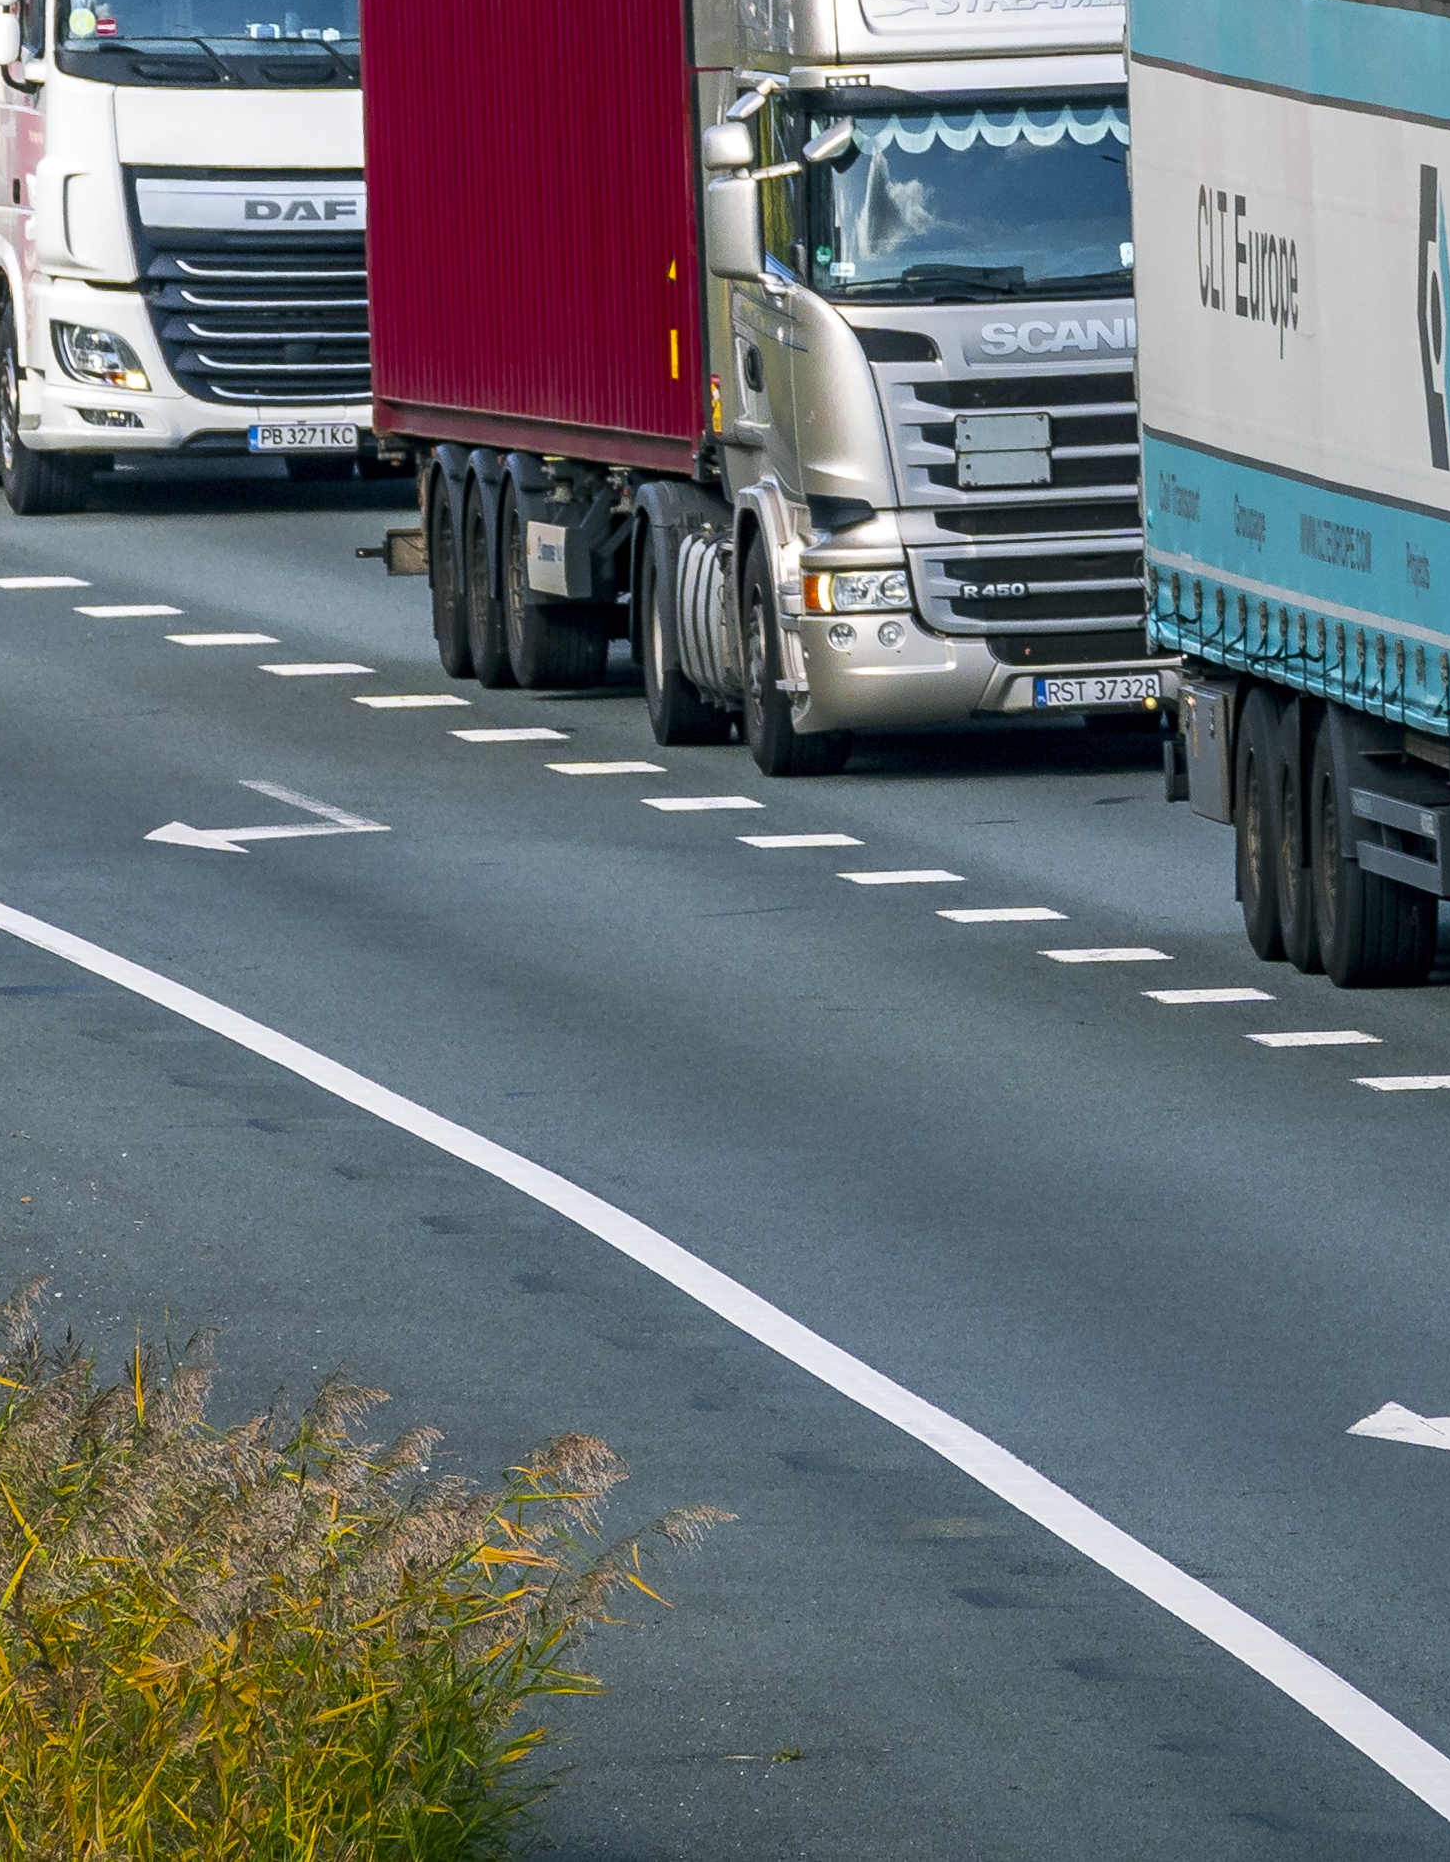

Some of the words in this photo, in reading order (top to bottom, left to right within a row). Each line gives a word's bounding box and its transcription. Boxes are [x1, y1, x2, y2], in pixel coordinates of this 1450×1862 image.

[244, 199, 358, 221] DAF
[1198, 183, 1226, 313] CLT
[1234, 194, 1299, 360] Europe
[260, 428, 283, 445] PB
[286, 427, 326, 445] 3271
[330, 426, 354, 444] KC
[963, 584, 979, 599] R
[981, 581, 1025, 598] 450
[1050, 681, 1087, 703] RST
[1095, 678, 1157, 701] 37328
